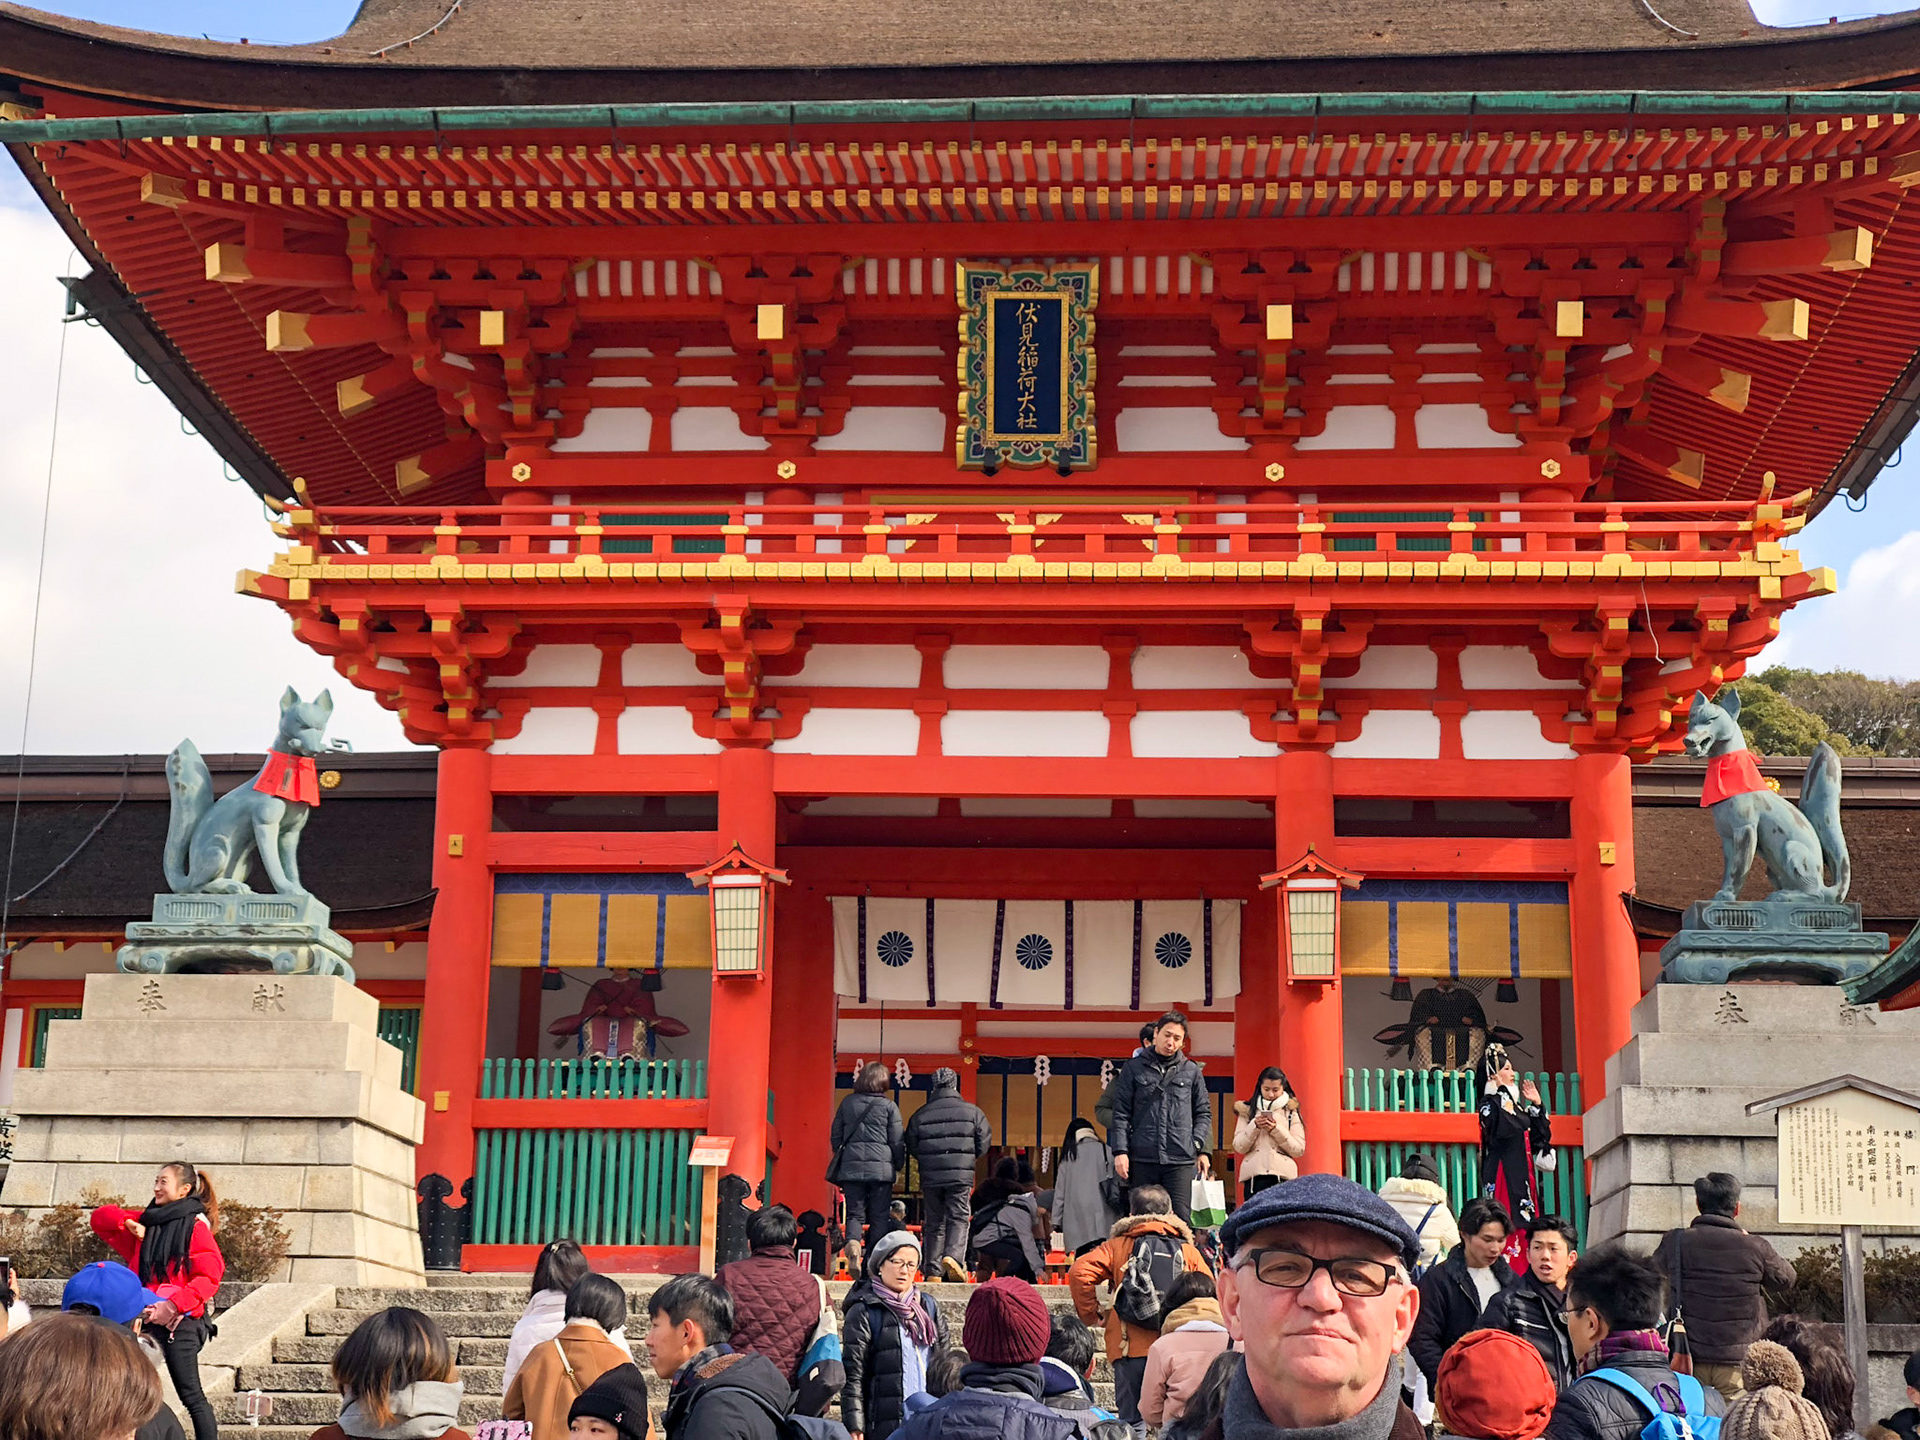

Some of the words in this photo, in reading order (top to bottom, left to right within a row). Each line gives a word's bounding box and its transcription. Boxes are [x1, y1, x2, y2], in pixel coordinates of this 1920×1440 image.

[1015, 303, 1041, 430] 伏見稲荷大社
[137, 979, 167, 1018] 奉
[251, 983, 286, 1014] 献
[1714, 990, 1749, 1030] 奉
